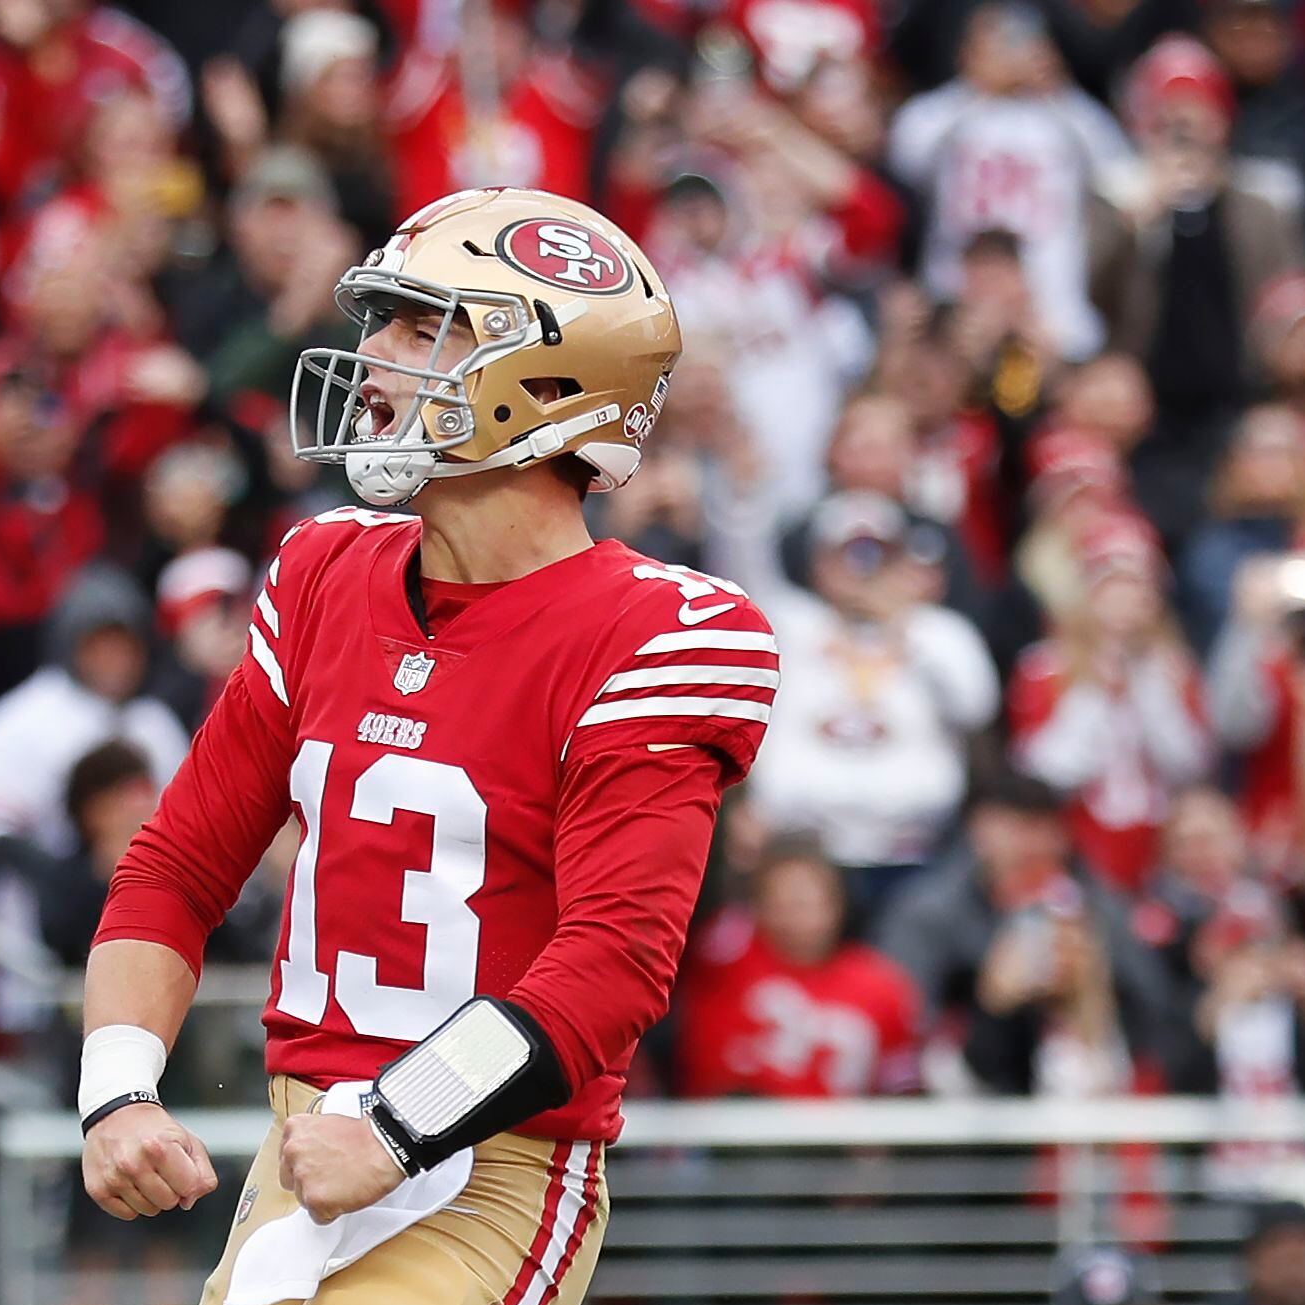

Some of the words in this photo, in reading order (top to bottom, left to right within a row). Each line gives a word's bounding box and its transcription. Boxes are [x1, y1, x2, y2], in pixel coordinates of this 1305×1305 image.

[595, 410, 608, 424] 13
[357, 712, 428, 750] 49ERS
[277, 739, 488, 1043] 13
